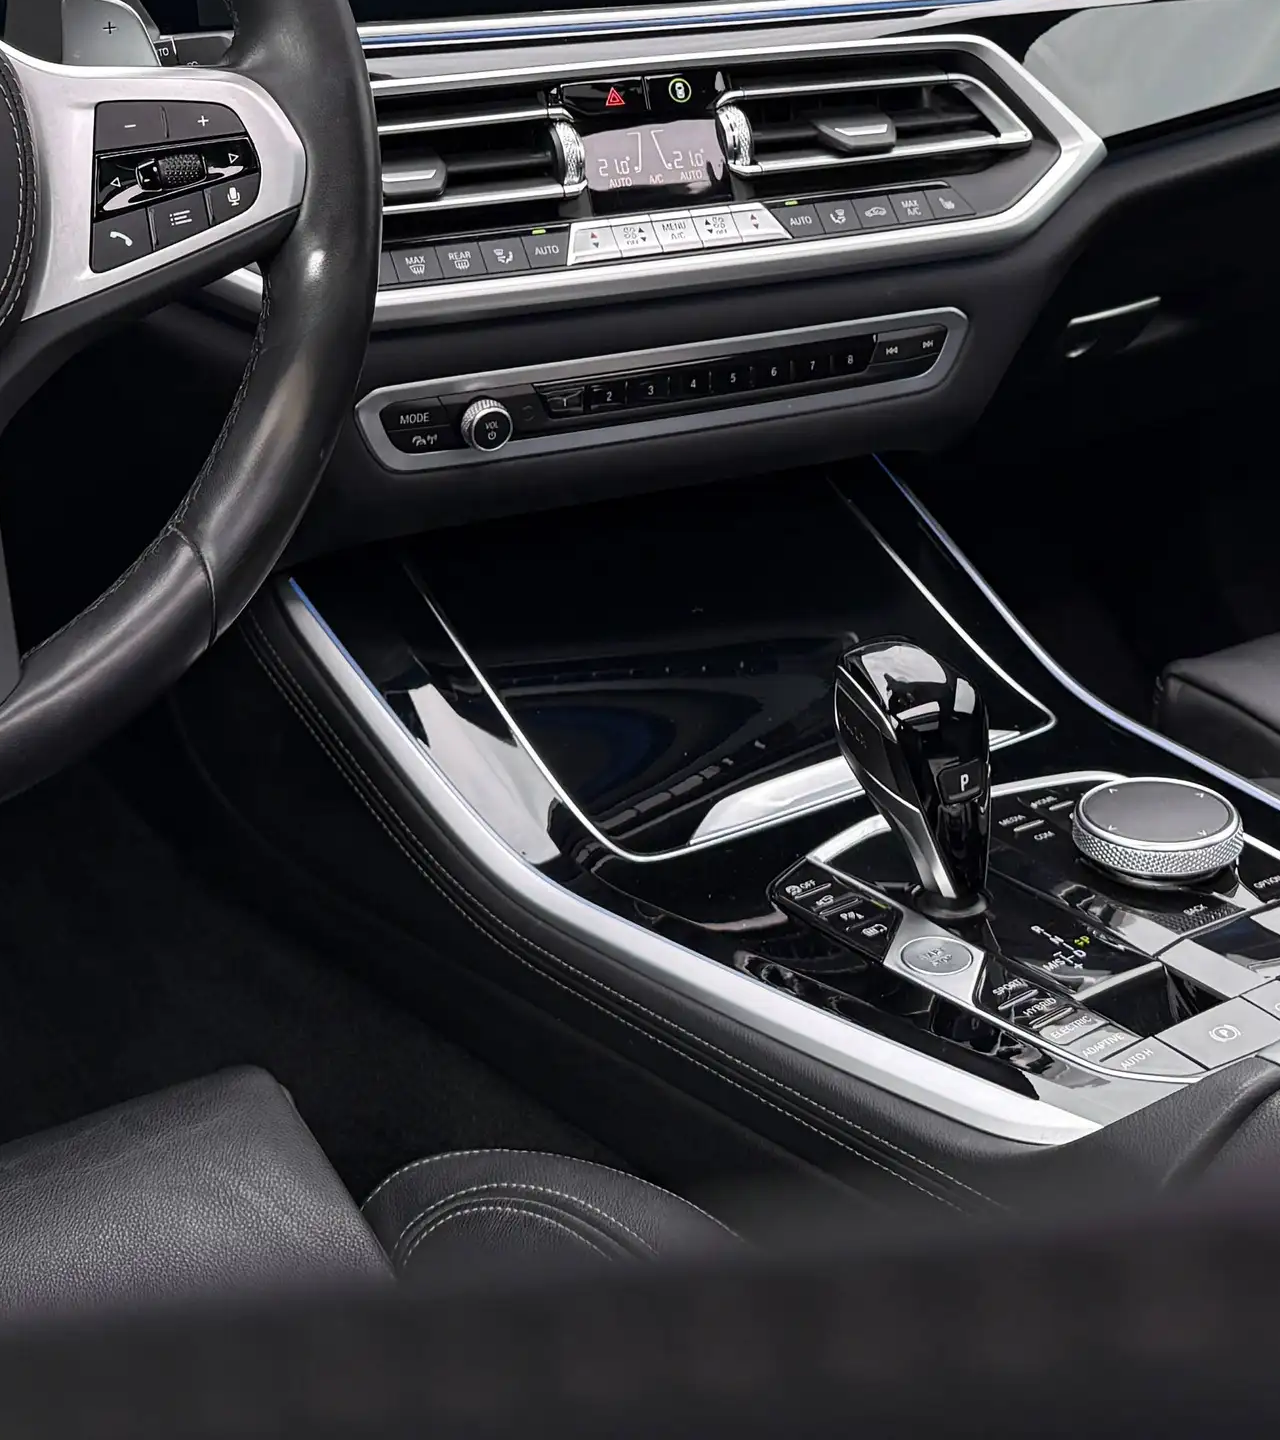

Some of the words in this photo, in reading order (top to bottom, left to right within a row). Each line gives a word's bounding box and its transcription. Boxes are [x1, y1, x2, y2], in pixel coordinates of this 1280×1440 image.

[609, 177, 632, 188] AUTO
[680, 170, 702, 181] AUTO
[901, 199, 919, 209] MAX
[662, 221, 687, 231] MENU
[790, 215, 812, 226] AUTO
[448, 251, 471, 261] REAR
[535, 245, 559, 256] AUTO
[405, 255, 426, 265] MAX
[810, 360, 816, 371] 7
[771, 366, 777, 377] 6
[690, 378, 697, 388] 4
[730, 373, 737, 383] 5
[648, 385, 654, 396] 3
[606, 391, 613, 402] 2
[399, 412, 430, 425] MODE
[485, 420, 499, 430] VOL
[960, 773, 969, 791] P
[1023, 997, 1057, 1017] HYBRID
[1050, 1015, 1093, 1039] ELECTRIC
[1082, 1032, 1125, 1058] ADAPTIVE
[1120, 1052, 1146, 1071] AUTO
